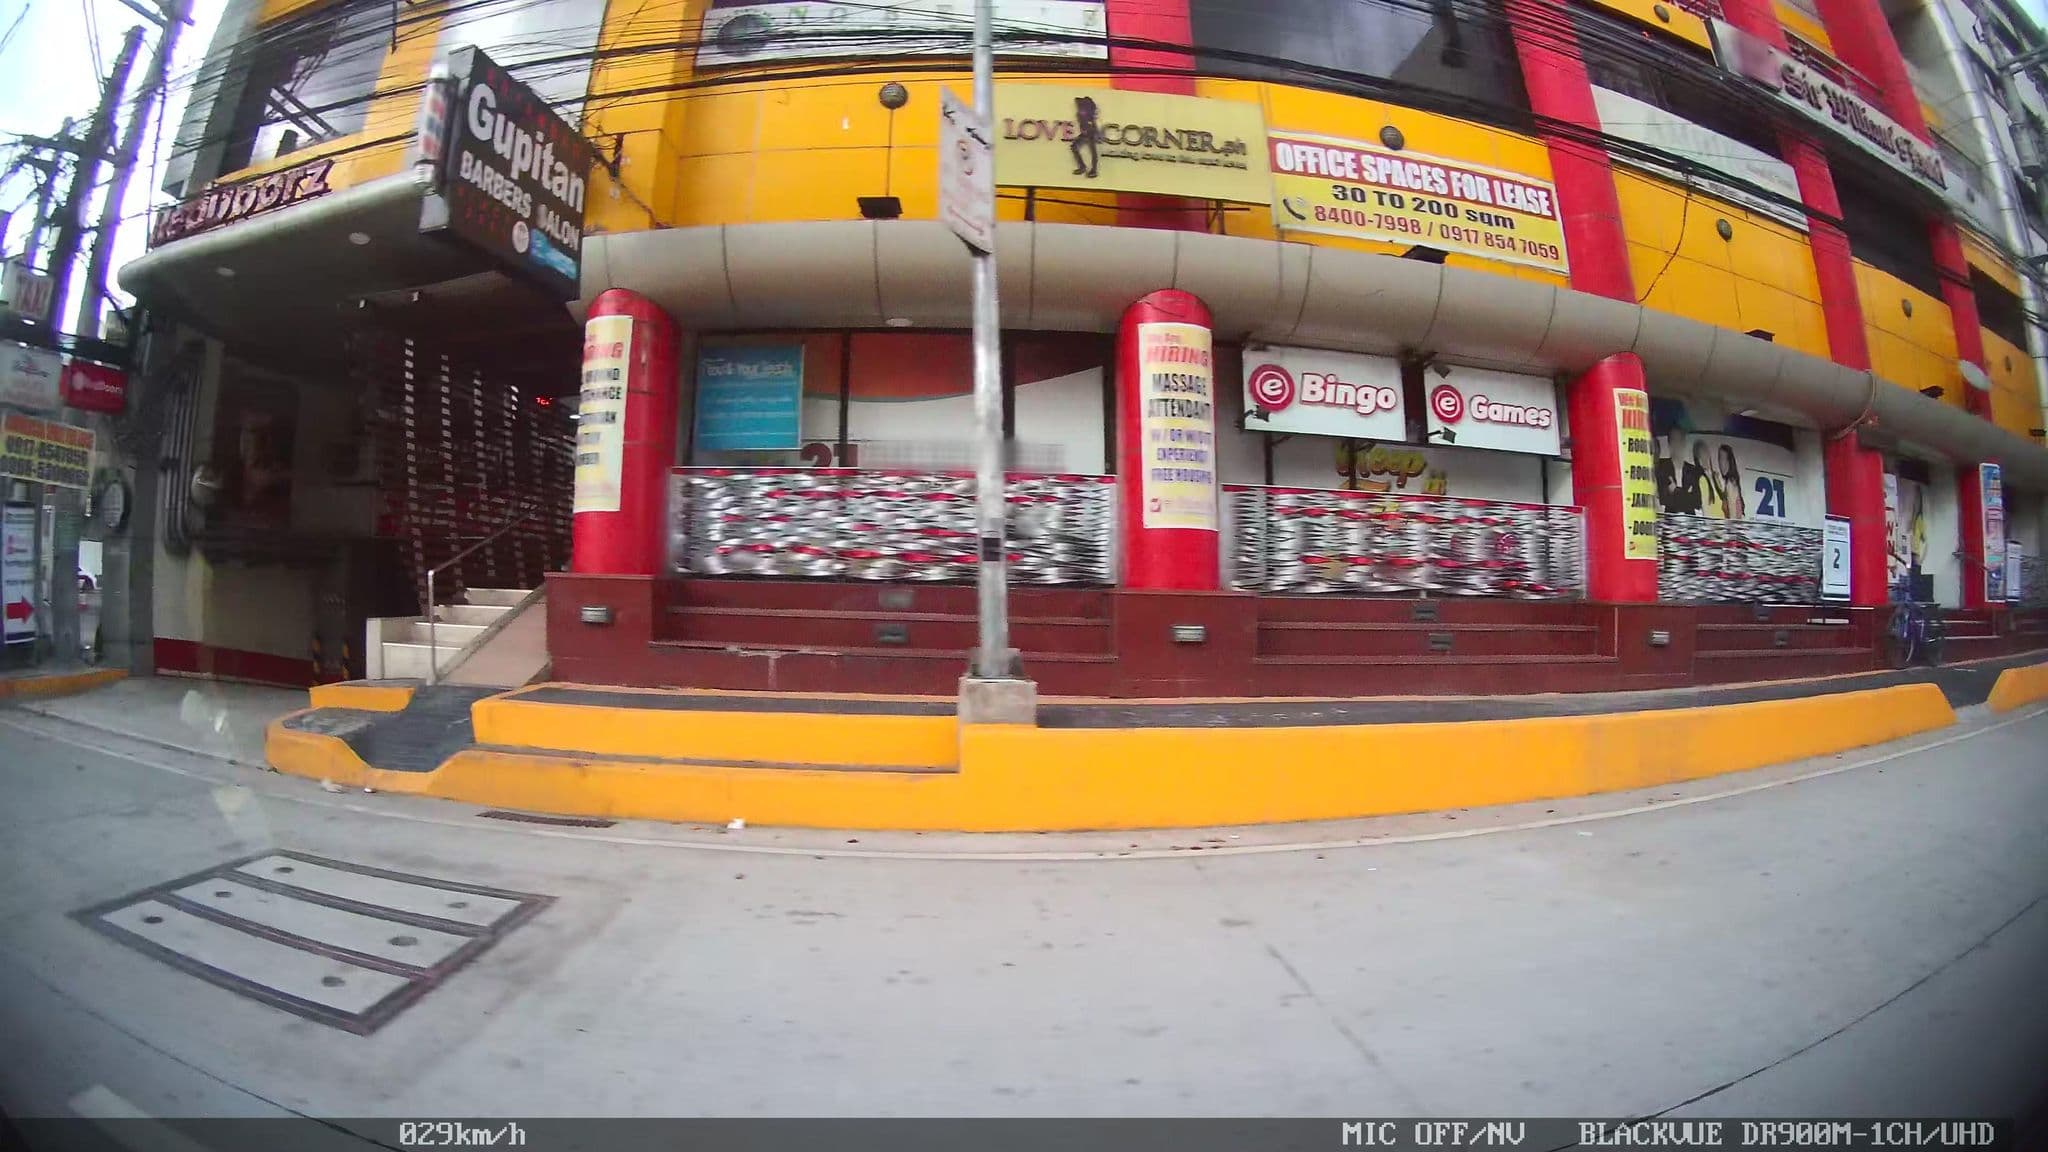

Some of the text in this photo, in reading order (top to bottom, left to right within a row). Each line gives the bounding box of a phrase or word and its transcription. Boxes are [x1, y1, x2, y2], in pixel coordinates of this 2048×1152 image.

[468, 83, 585, 213] Gupitan
[1003, 117, 1074, 142] LOVE
[460, 150, 532, 219] BARBERS
[1275, 142, 1358, 180] OFFICE
[1360, 154, 1448, 196] SPACES
[1450, 167, 1493, 204] FOR
[1494, 174, 1553, 217] LEASE
[1331, 184, 1515, 230] 30 TO 200 sqm
[1314, 205, 1421, 235] 8400-7998
[1440, 223, 1479, 245] 0917
[1484, 232, 1516, 252] 854
[1519, 239, 1560, 260] 7059
[1145, 345, 1209, 367] HIRING
[1152, 373, 1208, 396] MASSAGE
[1300, 372, 1398, 417] Bingo
[1149, 399, 1211, 421] ATTENDANT
[1470, 394, 1552, 429] Games
[1755, 476, 1786, 518] 21
[1833, 547, 1841, 569] 2
